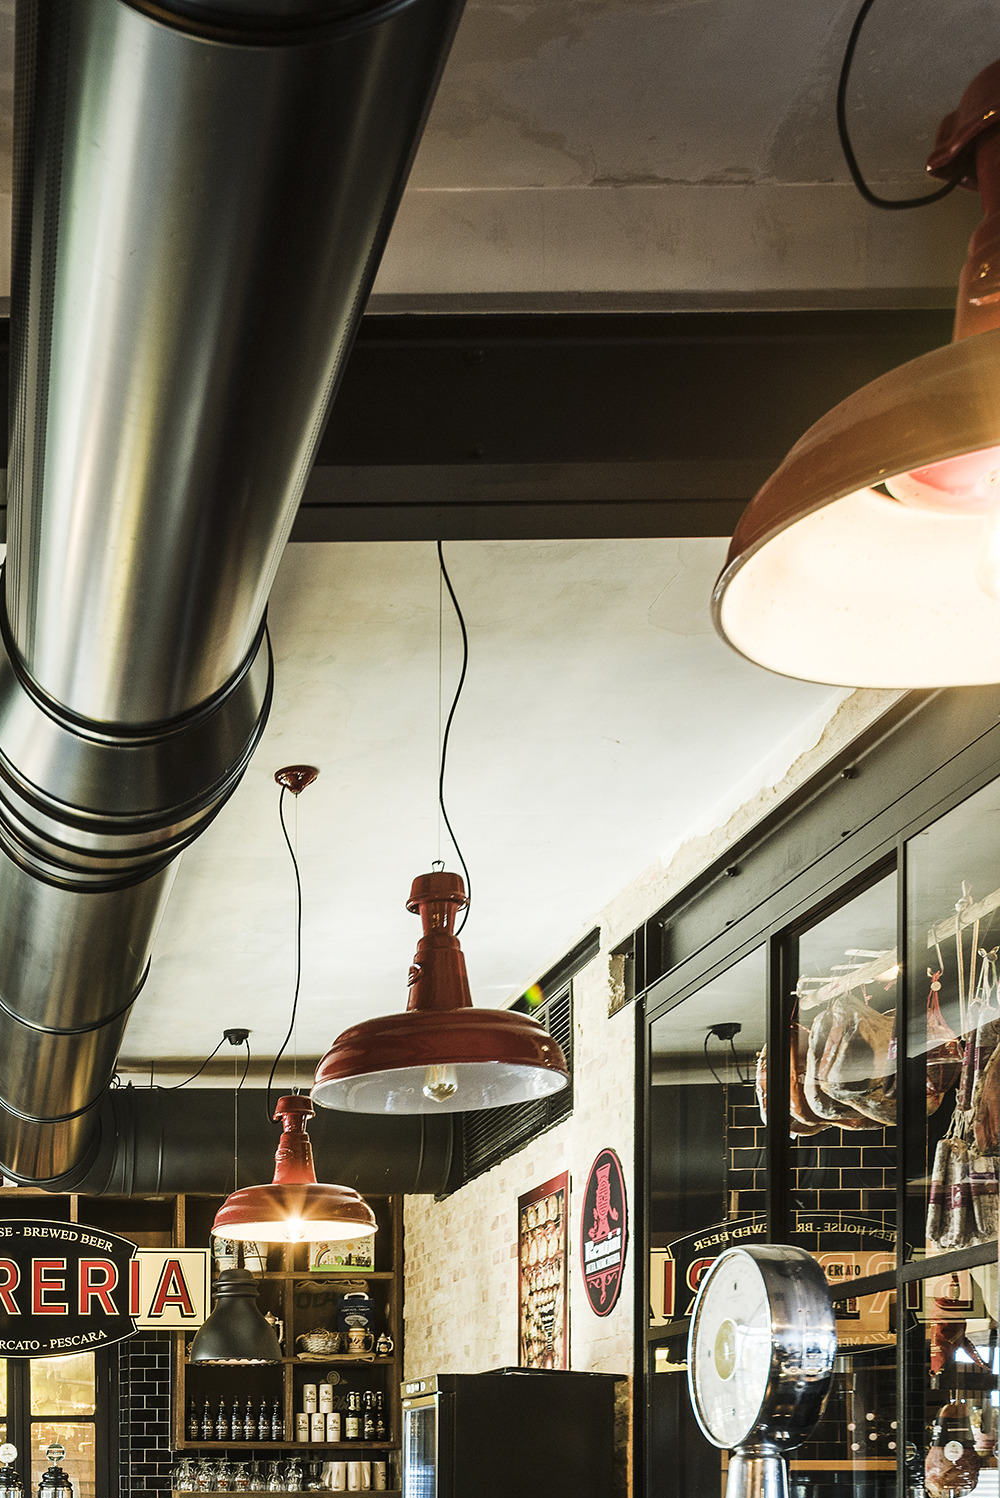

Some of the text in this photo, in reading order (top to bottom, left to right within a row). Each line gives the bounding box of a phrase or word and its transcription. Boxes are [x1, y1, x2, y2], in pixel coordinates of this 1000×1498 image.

[23, 1228, 78, 1243] BREWED
[78, 1231, 114, 1253] BEER
[822, 1265, 861, 1277] ERCATO
[49, 1329, 108, 1350] PESCARA
